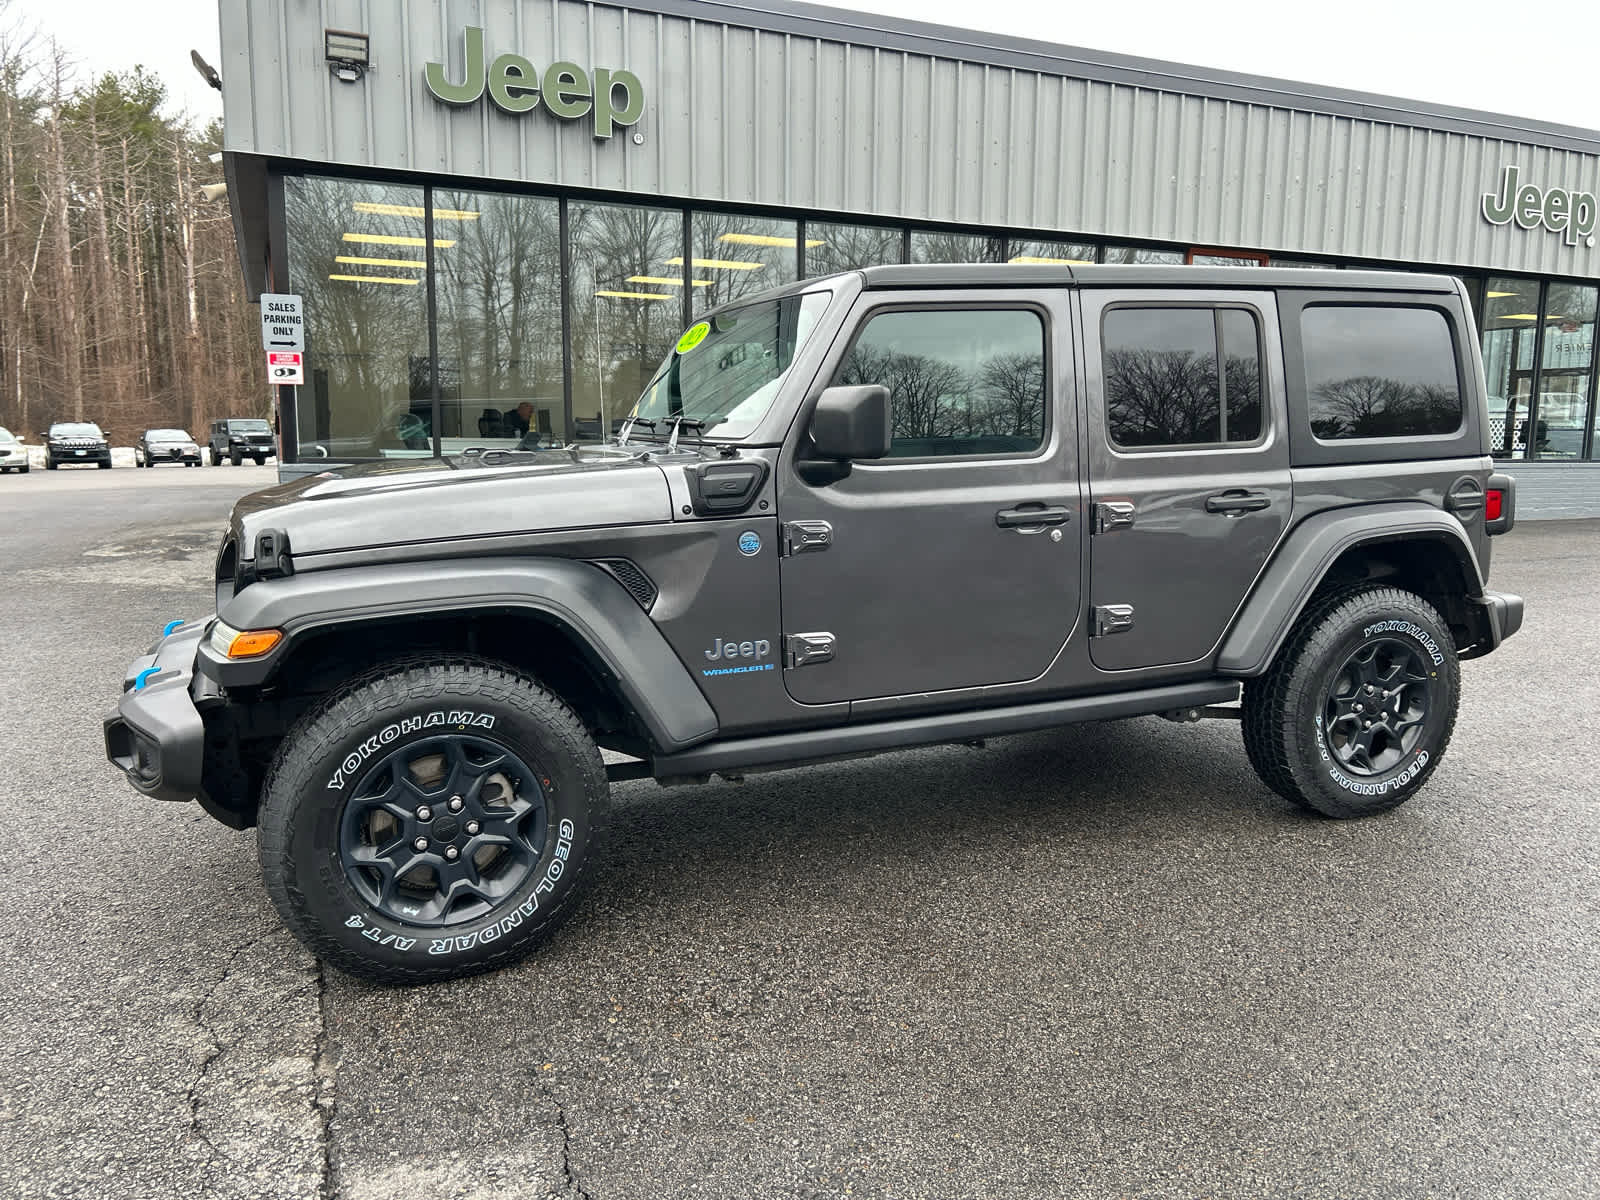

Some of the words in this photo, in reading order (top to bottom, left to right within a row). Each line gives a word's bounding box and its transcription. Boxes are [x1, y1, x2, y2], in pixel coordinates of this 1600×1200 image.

[425, 26, 644, 137] Jeep
[1483, 165, 1597, 245] Jeep
[264, 315, 301, 325] PARKING
[268, 303, 296, 312] SALES
[273, 327, 294, 336] ONLY
[704, 638, 770, 661] Jeep
[1364, 620, 1445, 667] YOKOHAMA
[703, 665, 763, 676] WRANGLER
[328, 711, 495, 791] YOKOHAMA
[1329, 750, 1429, 796] GEOLANDAR
[428, 818, 574, 955] GEOLANDAR
